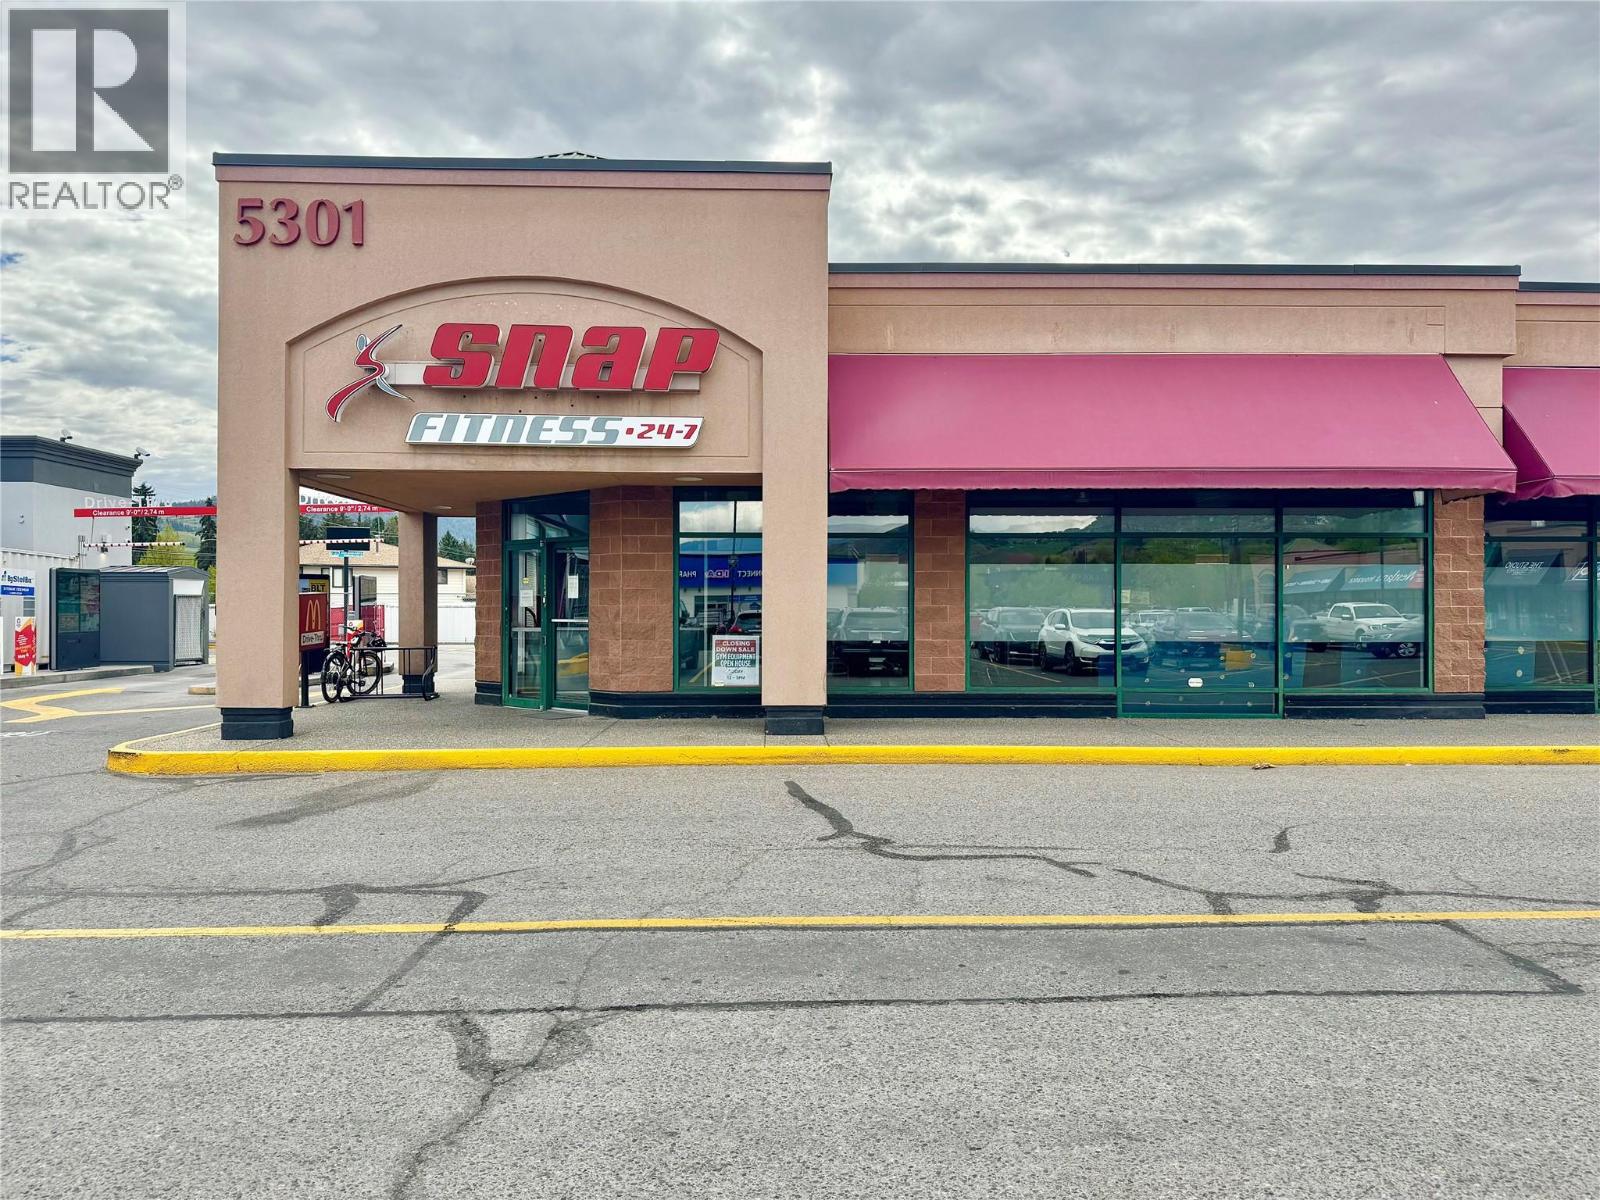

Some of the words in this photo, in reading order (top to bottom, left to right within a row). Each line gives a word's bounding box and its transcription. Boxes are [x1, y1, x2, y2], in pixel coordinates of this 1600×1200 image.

[234, 198, 364, 246] 5301
[408, 414, 622, 444] FITNESS
[311, 584, 326, 592] BLT
